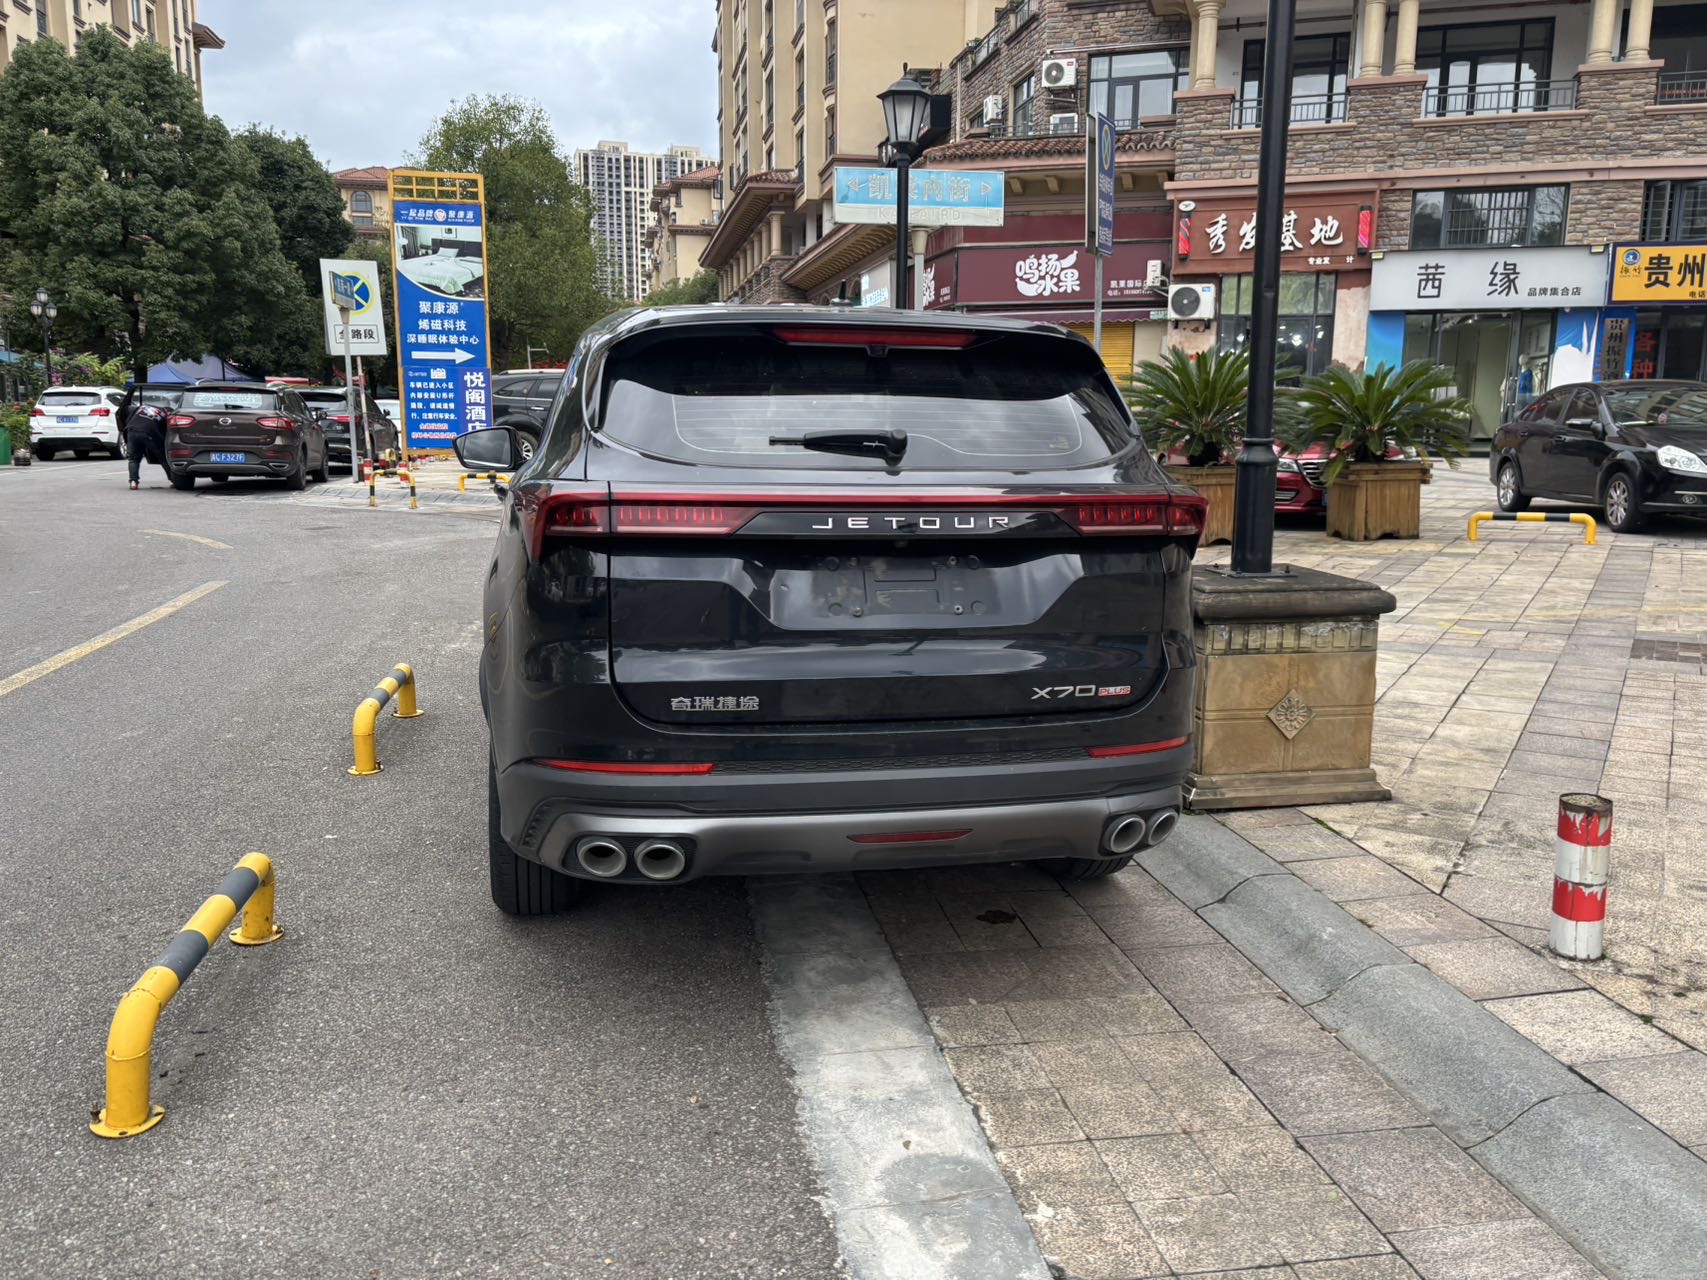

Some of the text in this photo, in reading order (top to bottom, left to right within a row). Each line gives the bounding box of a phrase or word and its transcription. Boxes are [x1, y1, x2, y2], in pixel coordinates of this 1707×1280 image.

[1643, 253, 1706, 288] 贵州
[1527, 286, 1582, 297] 品牌集合店
[1689, 290, 1706, 299] 电话
[418, 301, 459, 315] 聚康源
[418, 318, 467, 332] 烯磁科技
[406, 333, 479, 345] 深睡眠体验中心
[811, 517, 1008, 529] JETOUR
[1031, 684, 1132, 700] X70 PLUS
[670, 695, 760, 711] 奇瑞捷途
